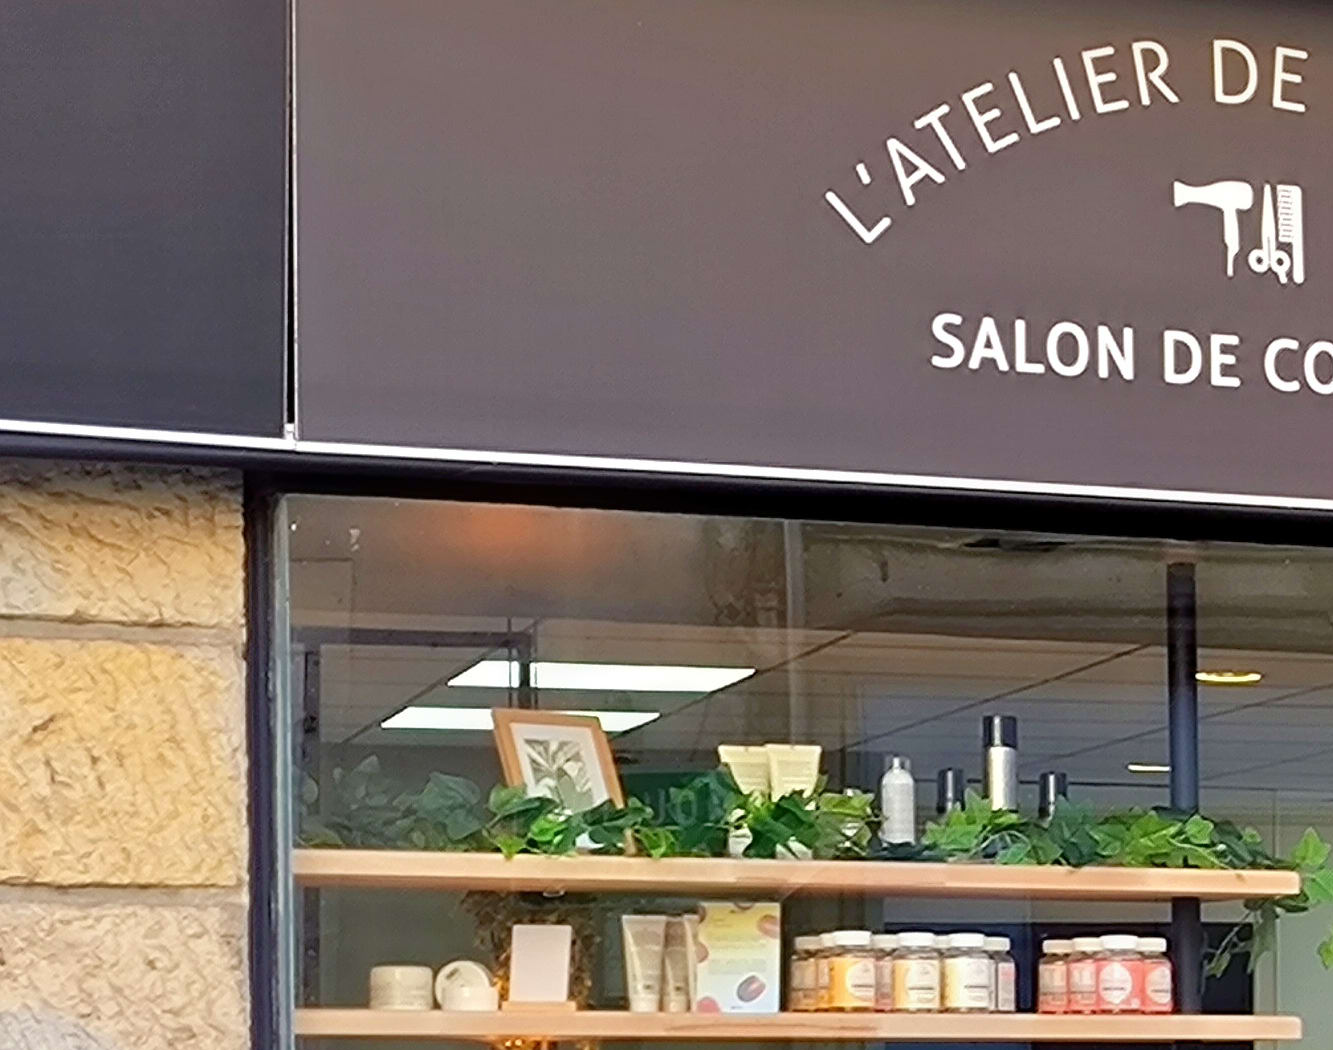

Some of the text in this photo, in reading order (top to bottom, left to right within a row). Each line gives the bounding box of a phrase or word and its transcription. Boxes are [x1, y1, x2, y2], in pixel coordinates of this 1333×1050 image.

[825, 41, 1179, 244] L'ATELIER
[1213, 39, 1308, 113] DE
[931, 313, 1134, 380] SALON
[1163, 330, 1241, 388] DE
